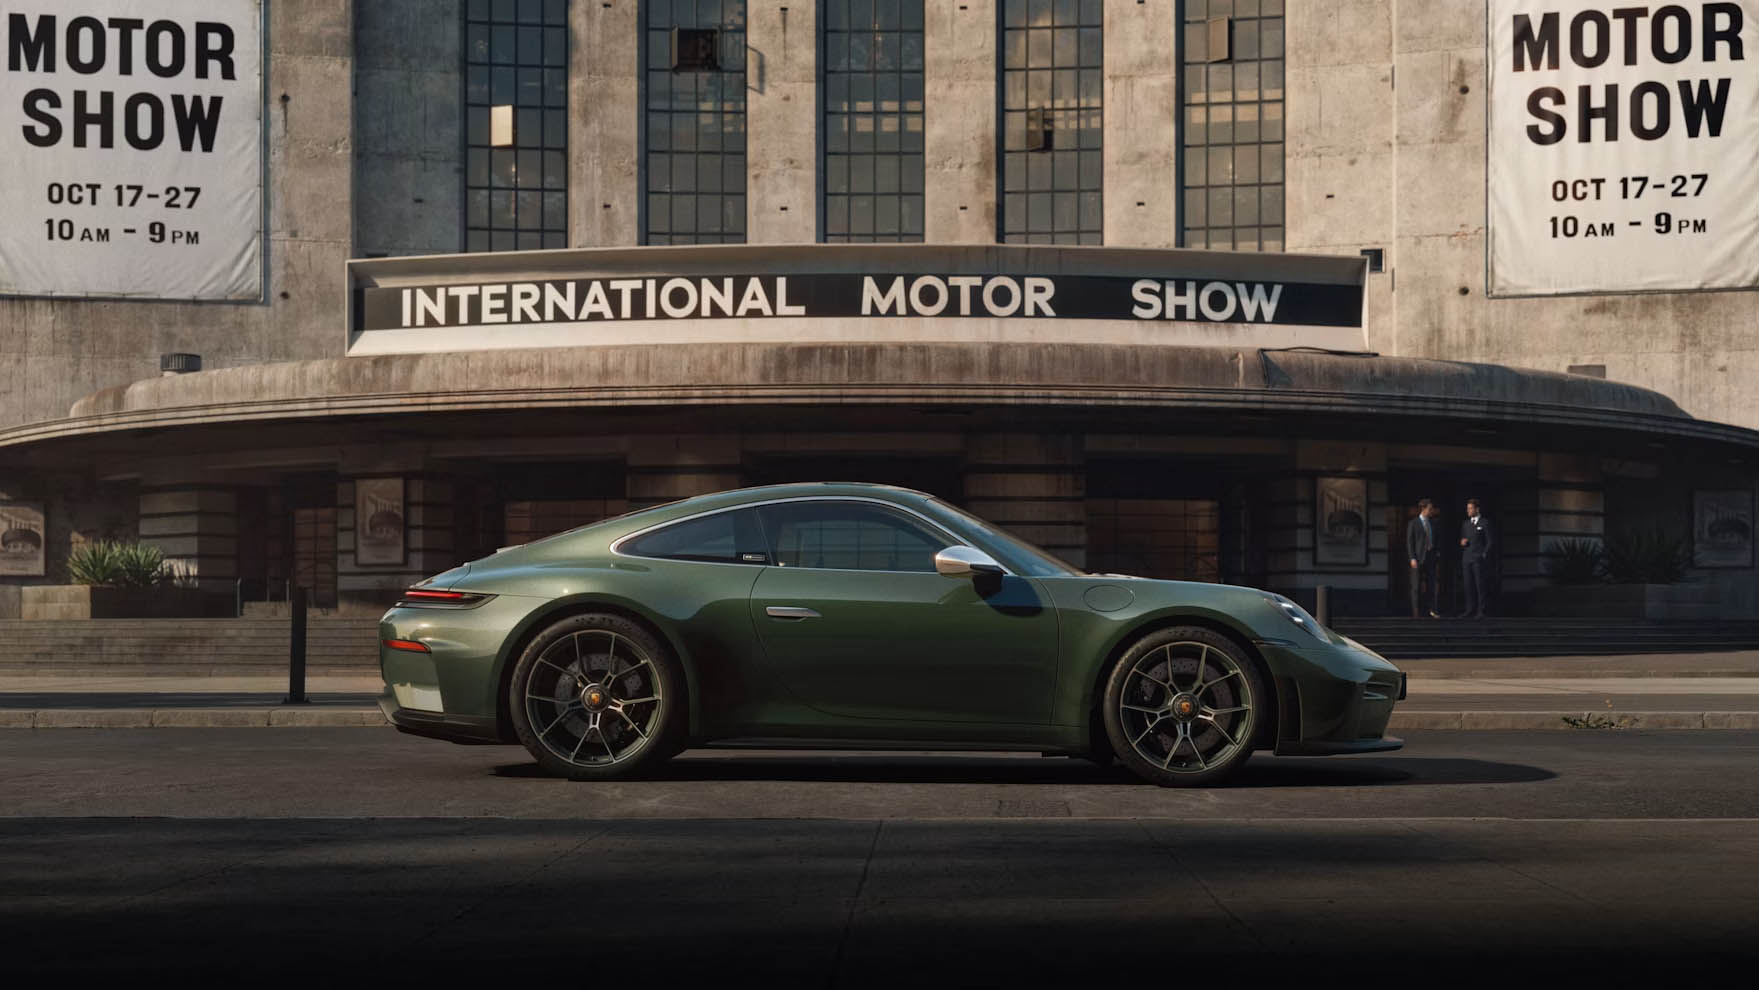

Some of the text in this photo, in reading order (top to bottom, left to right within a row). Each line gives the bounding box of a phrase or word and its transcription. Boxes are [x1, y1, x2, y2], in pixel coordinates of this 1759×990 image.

[8, 13, 237, 81] MOTOR
[1512, 2, 1745, 72] MOTOR
[22, 88, 224, 153] SHOW
[1526, 78, 1732, 146] SHOW
[47, 182, 202, 209] OCT 17-27
[1552, 173, 1709, 202] OCT 17-27
[401, 275, 1283, 328] INTERNATIONAL MOTOR SHOW
